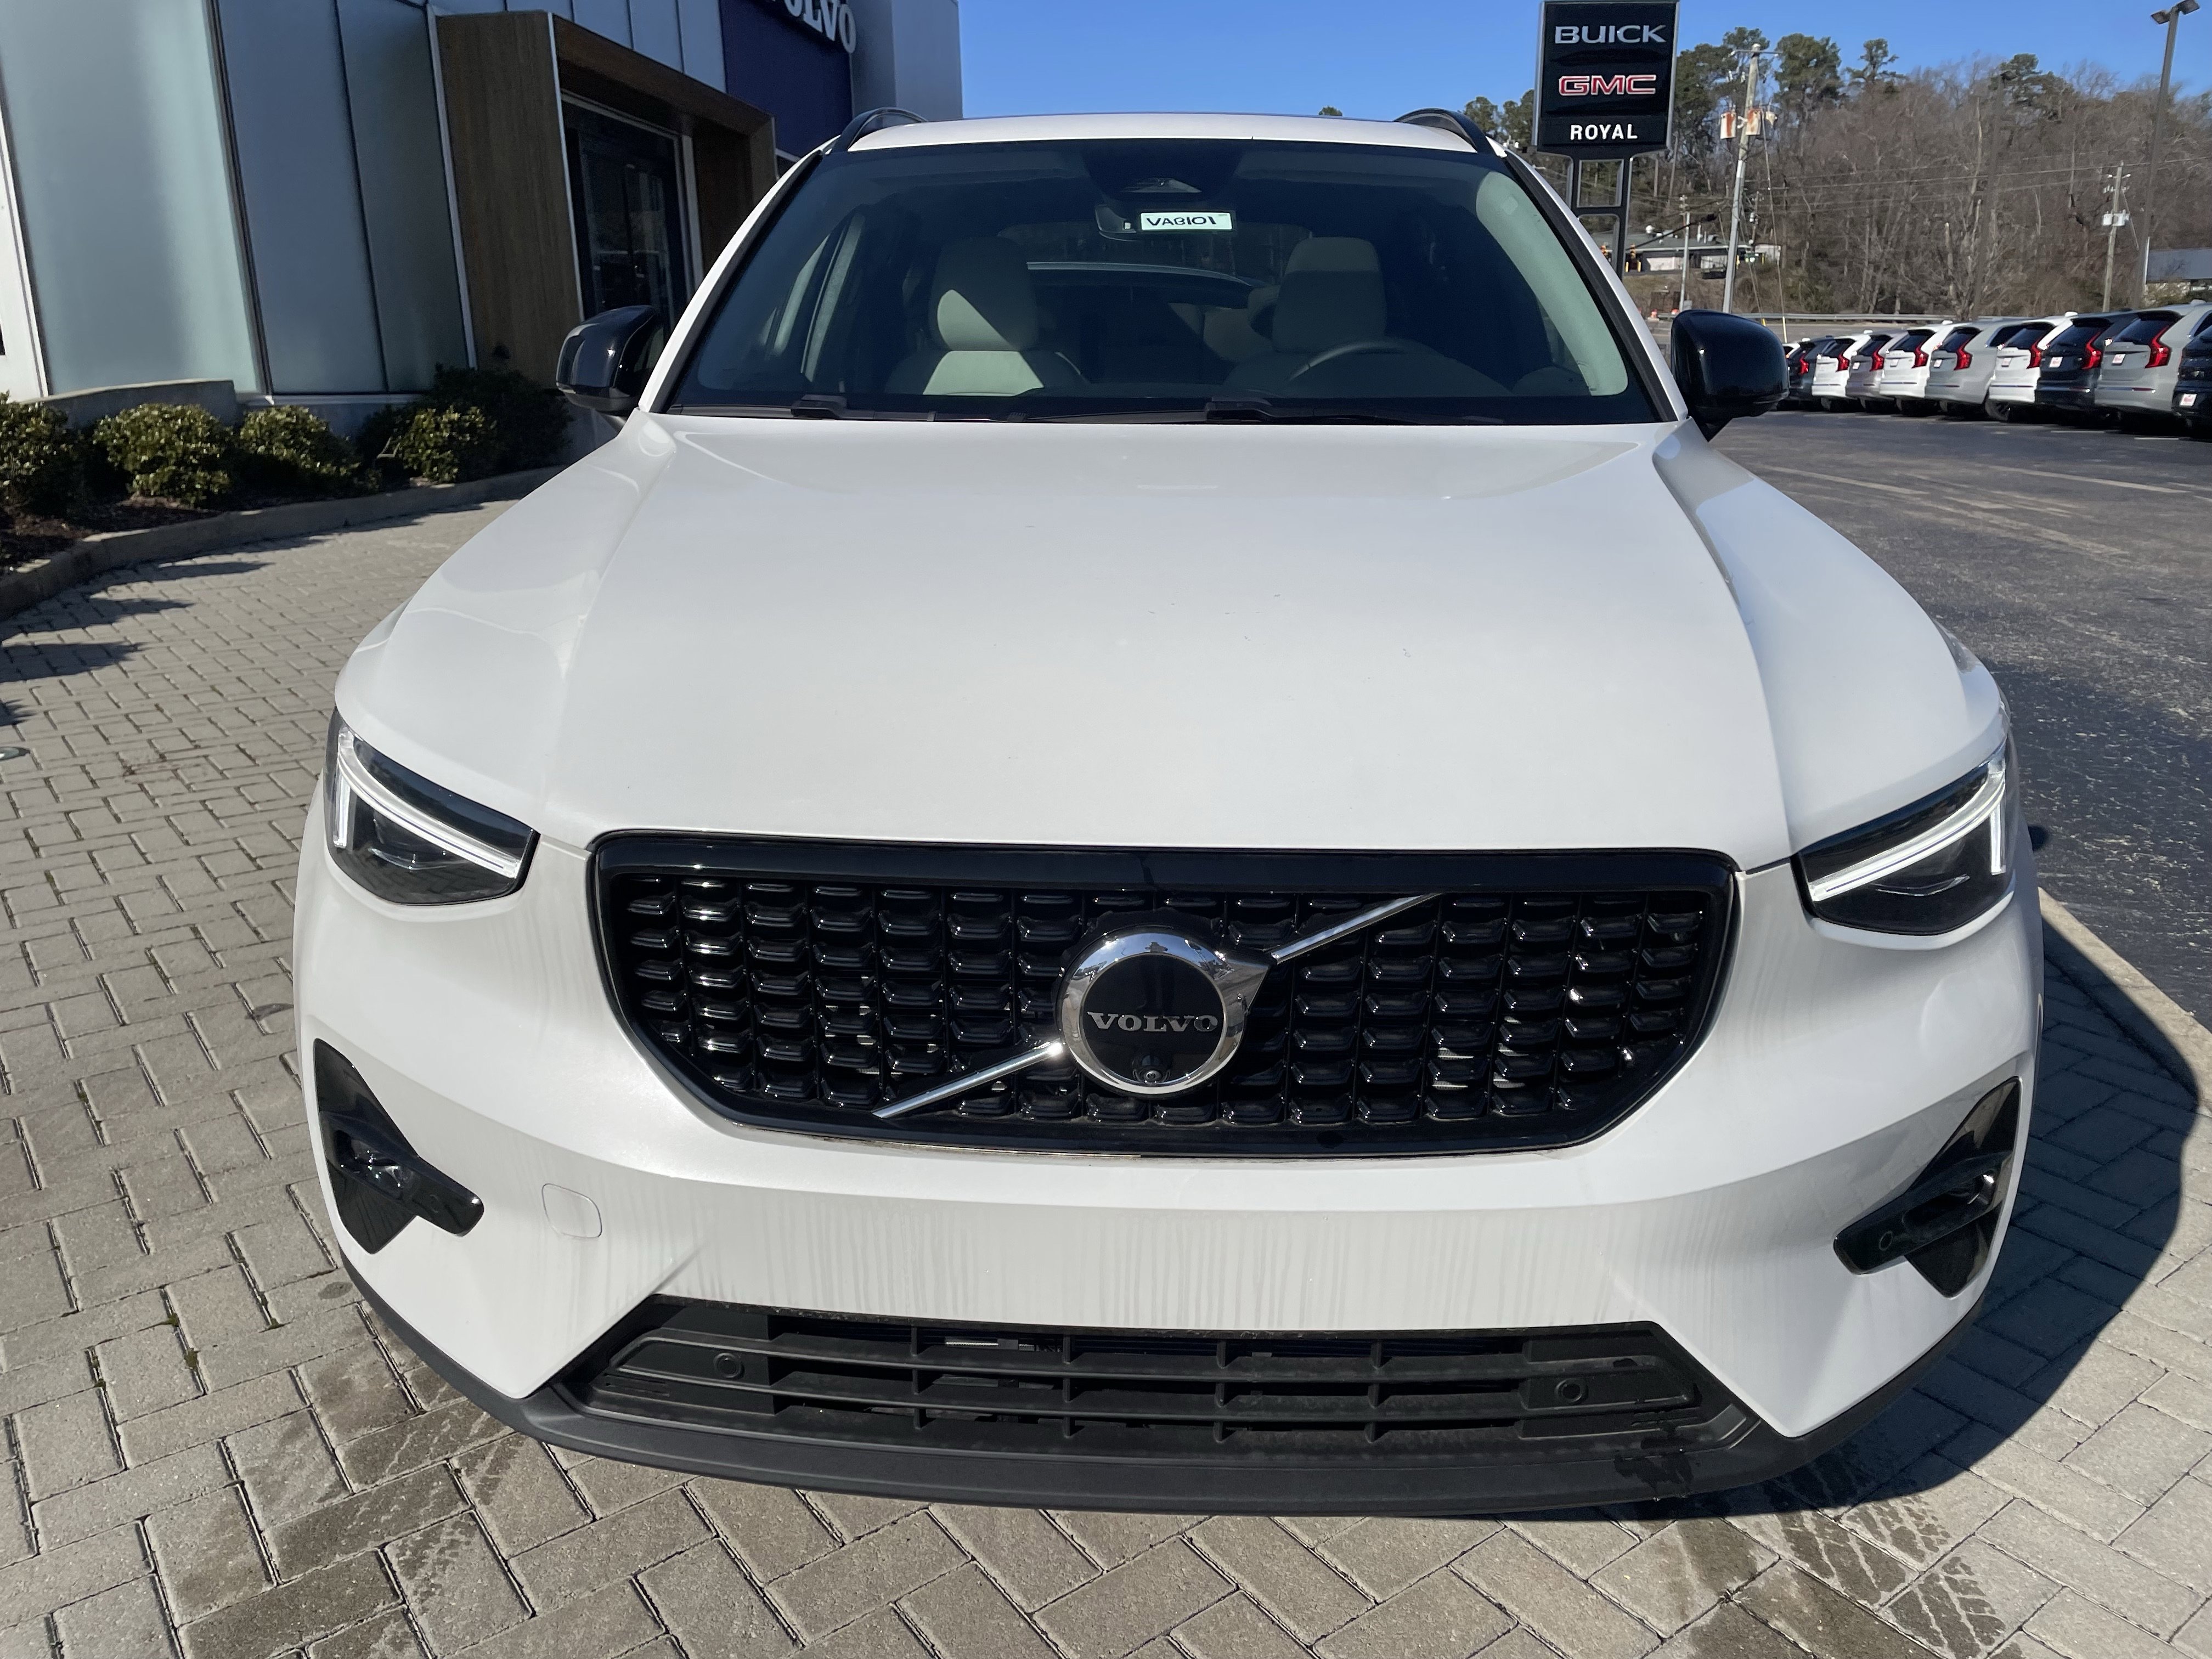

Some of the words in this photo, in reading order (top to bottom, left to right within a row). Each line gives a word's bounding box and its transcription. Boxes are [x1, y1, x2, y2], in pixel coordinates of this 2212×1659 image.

[1555, 25, 1666, 44] BUICK
[1559, 75, 1657, 96] GMC
[1570, 124, 1638, 140] ROYAL
[1087, 1012, 1218, 1032] VOLVO
